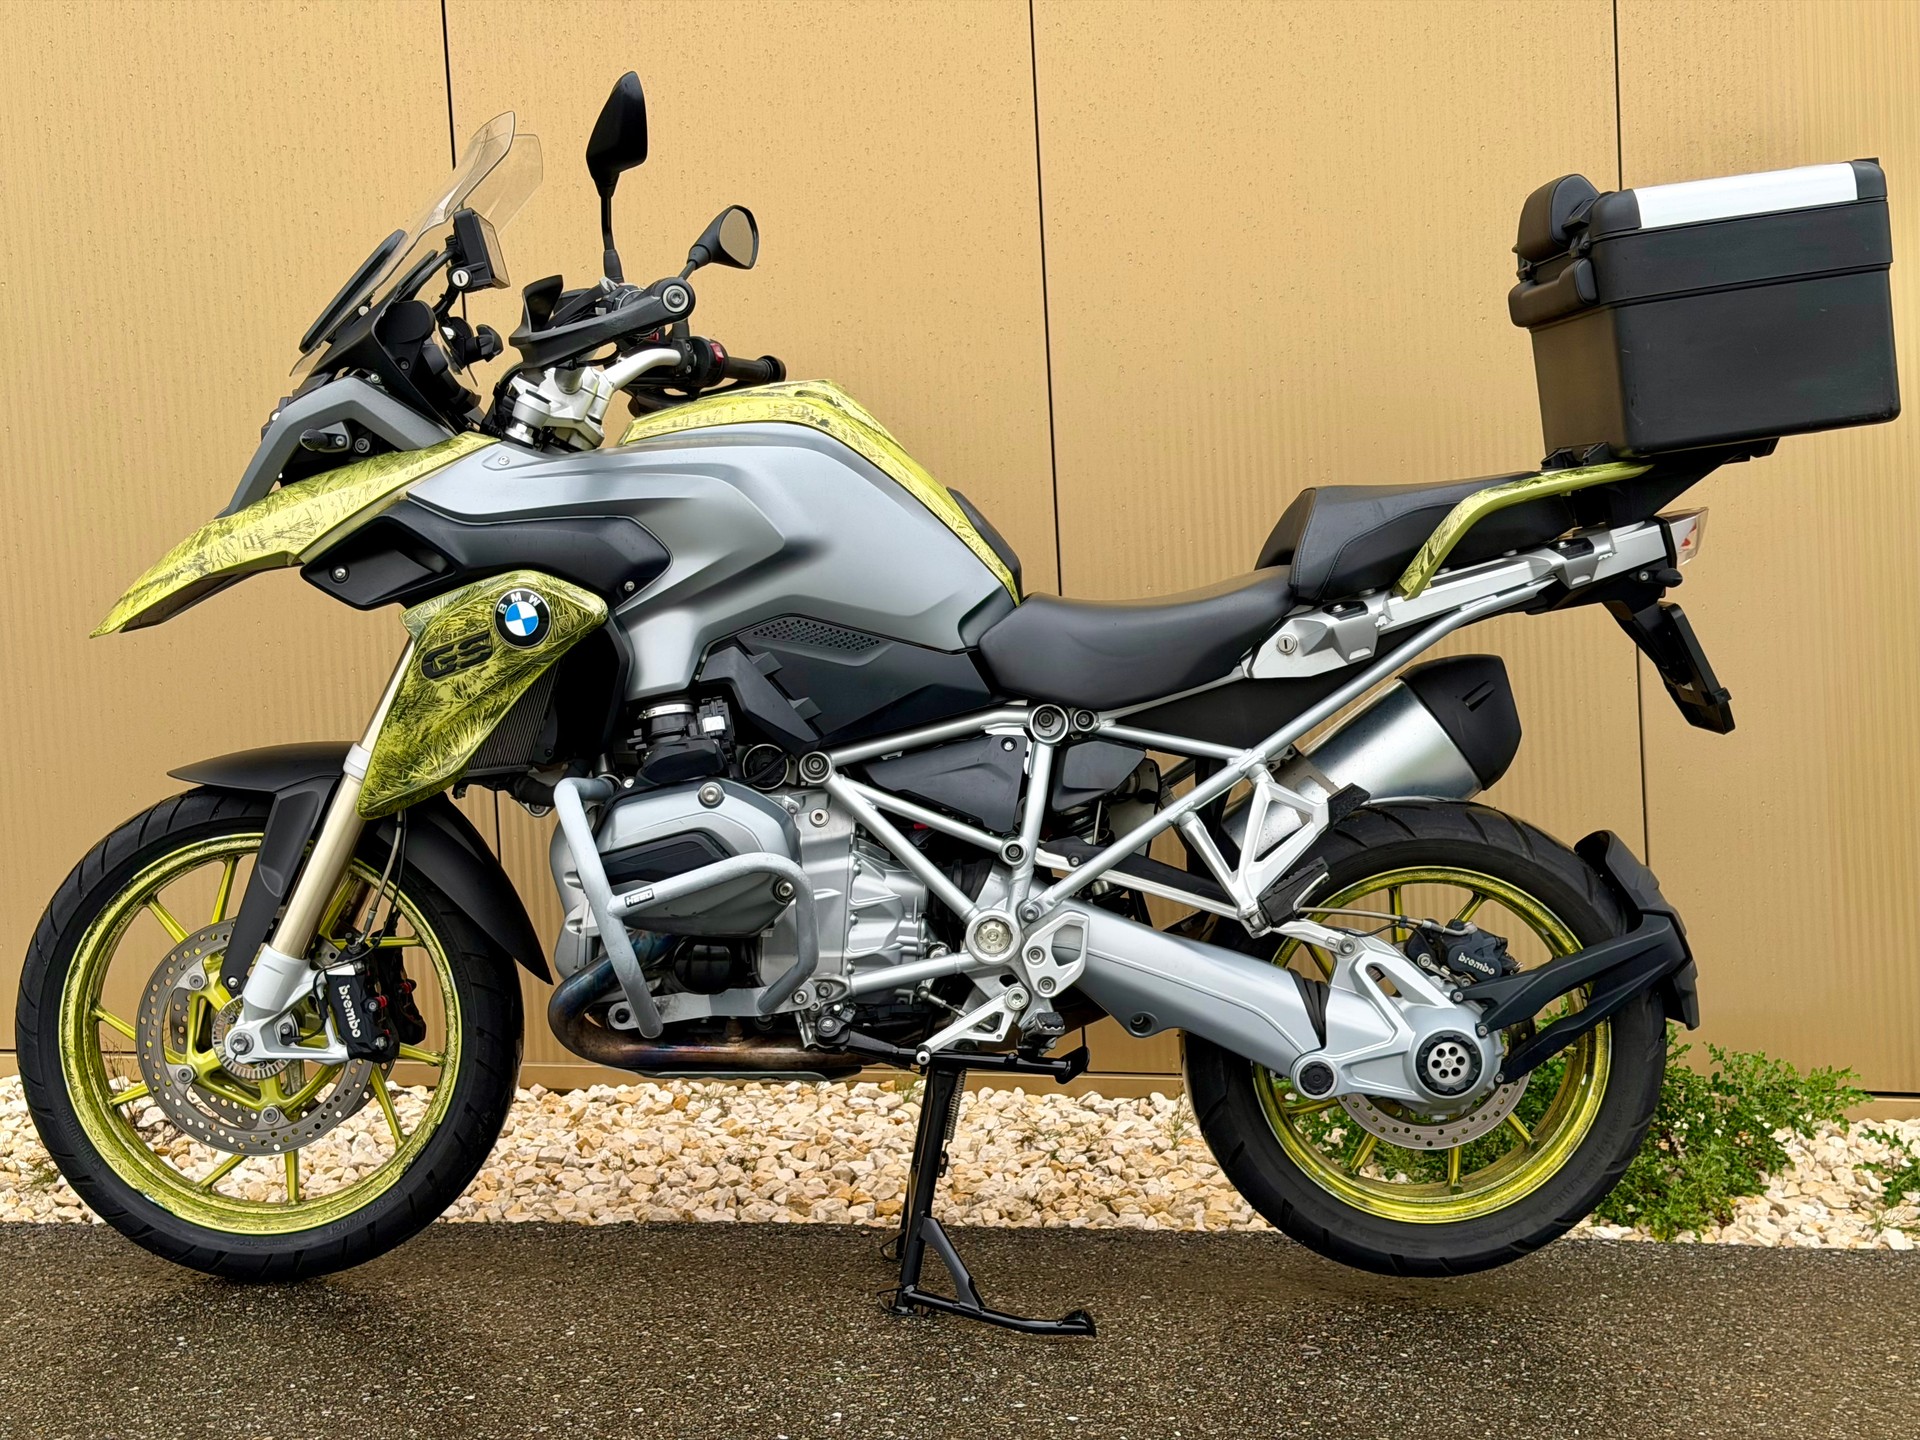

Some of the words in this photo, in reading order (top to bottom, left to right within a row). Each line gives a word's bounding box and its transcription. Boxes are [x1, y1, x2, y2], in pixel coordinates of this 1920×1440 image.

[497, 591, 541, 615] BMW
[422, 629, 493, 679] GS
[1458, 952, 1495, 975] brembo
[338, 984, 361, 1038] brembo
